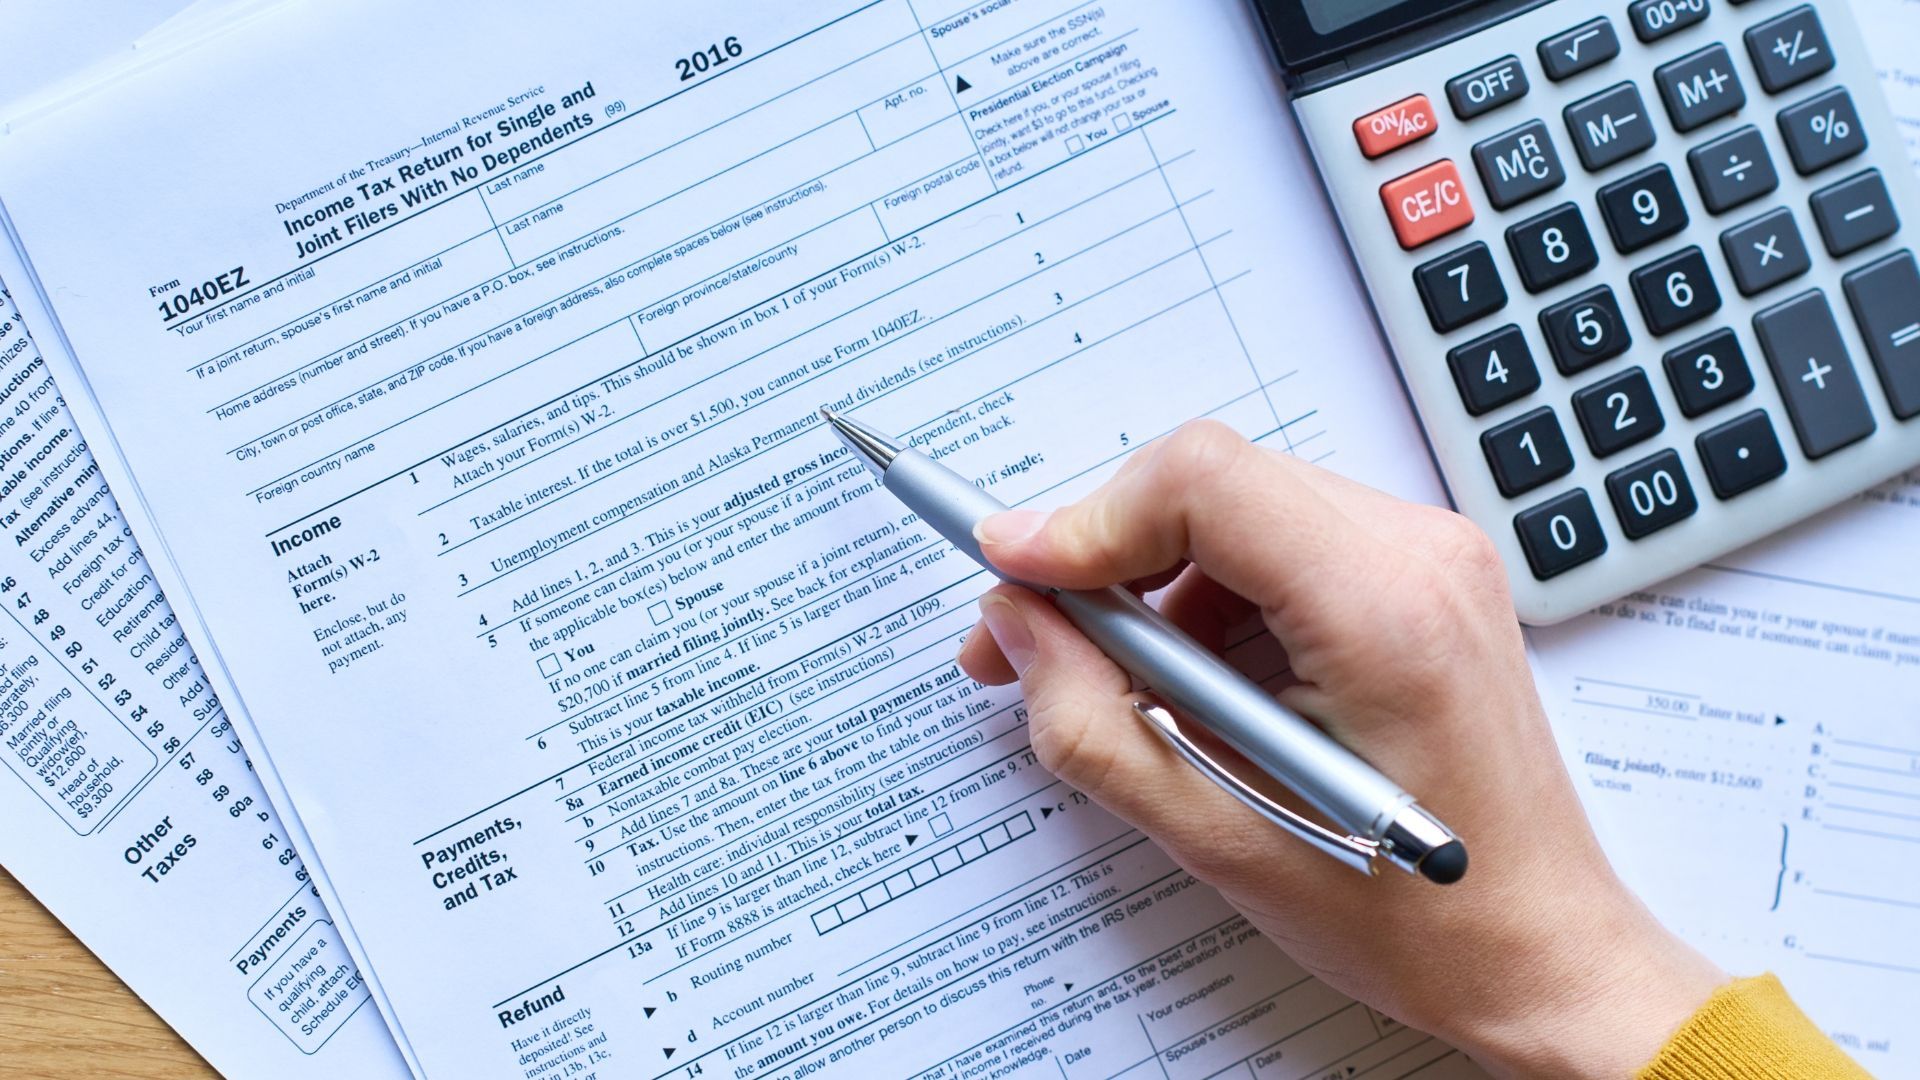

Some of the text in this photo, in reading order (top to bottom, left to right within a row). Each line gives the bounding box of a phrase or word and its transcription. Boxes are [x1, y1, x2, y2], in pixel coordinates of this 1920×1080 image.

[675, 36, 742, 81] 2016
[990, 47, 1021, 65] Make
[1023, 36, 1046, 51] sure
[1047, 26, 1066, 39] the
[1007, 27, 1101, 76] above are correct.
[885, 86, 927, 110] Apt. no.
[969, 44, 1127, 121] Presidential Election Campaign
[1467, 67, 1515, 104] OFF
[1676, 69, 1730, 109] M+
[604, 100, 626, 118] (99)
[1132, 99, 1169, 120] Spouse
[1370, 113, 1428, 137] ON/AC
[274, 181, 335, 214] Department
[336, 173, 347, 186] of
[348, 168, 365, 180] the
[461, 103, 505, 128] Revenue
[507, 86, 544, 107] Service
[1085, 128, 1107, 141] You
[283, 81, 595, 236] Income Tax Return for Single and
[296, 113, 593, 258] Joint Filers With No Dependents
[486, 163, 544, 195] Last name
[883, 160, 980, 209] Foreign postal code
[505, 203, 563, 235] Last name
[1400, 179, 1460, 223] CE/C
[1632, 189, 1661, 225] 9
[1541, 227, 1570, 263] 8
[149, 279, 180, 297] Form
[158, 266, 250, 322] 1040EZ
[175, 267, 315, 336] Your first name and initial
[637, 245, 797, 324] Foreign province/state/county
[1448, 264, 1470, 302] 7
[1666, 271, 1694, 308] 6
[196, 257, 442, 379] If a joint return, spouse's first name and initial
[215, 227, 624, 420] Home address (number and street). If you have a P.O. box, see instructions.
[1575, 307, 1603, 346] 5
[1484, 349, 1509, 384] 4
[1696, 353, 1724, 390] 3
[1606, 392, 1637, 430] 2
[453, 404, 615, 488] Attach your Form(s) W-2.
[1519, 431, 1542, 466] 1
[255, 443, 375, 503] Foreign country name
[1629, 469, 1678, 516] 00
[271, 516, 341, 556] Income
[1550, 514, 1577, 550] 0
[288, 554, 332, 583] Attach
[292, 549, 380, 598] Form(s) W-2
[299, 594, 335, 613] here.
[675, 582, 724, 610] Spouse
[313, 593, 405, 642] Enclose, but do
[321, 609, 406, 656] not attach, any
[328, 640, 383, 674] payment.
[564, 643, 595, 662] You
[98, 673, 116, 690] 52
[114, 689, 131, 706] 53
[6, 687, 71, 749] Married filing
[130, 705, 147, 722] 54
[147, 720, 164, 738] 55
[1699, 704, 1764, 725] Enter total
[15, 716, 58, 761] jointly or
[23, 719, 77, 767] Qualifying
[36, 726, 87, 779] widow(er),
[163, 736, 180, 753] 56
[44, 745, 85, 786] $12,600
[1584, 751, 1620, 769] filing
[1674, 768, 1706, 781] enter
[124, 815, 173, 864] Other
[141, 834, 196, 882] Taxes
[421, 817, 521, 869] Payments,
[432, 850, 507, 889] Credits,
[443, 866, 517, 910] and Tax
[236, 906, 306, 975] Payments
[690, 933, 792, 989] Routing number
[713, 972, 814, 1029] Account number
[1023, 976, 1054, 995] Phone
[1030, 998, 1046, 1009] no.
[1145, 974, 1234, 1022] Your occupation
[498, 985, 565, 1028] Refund
[510, 1008, 590, 1052] Have it directly
[519, 1024, 593, 1065] deposited! See
[524, 1031, 607, 1079] instructions and
[1064, 1047, 1091, 1064] Date
